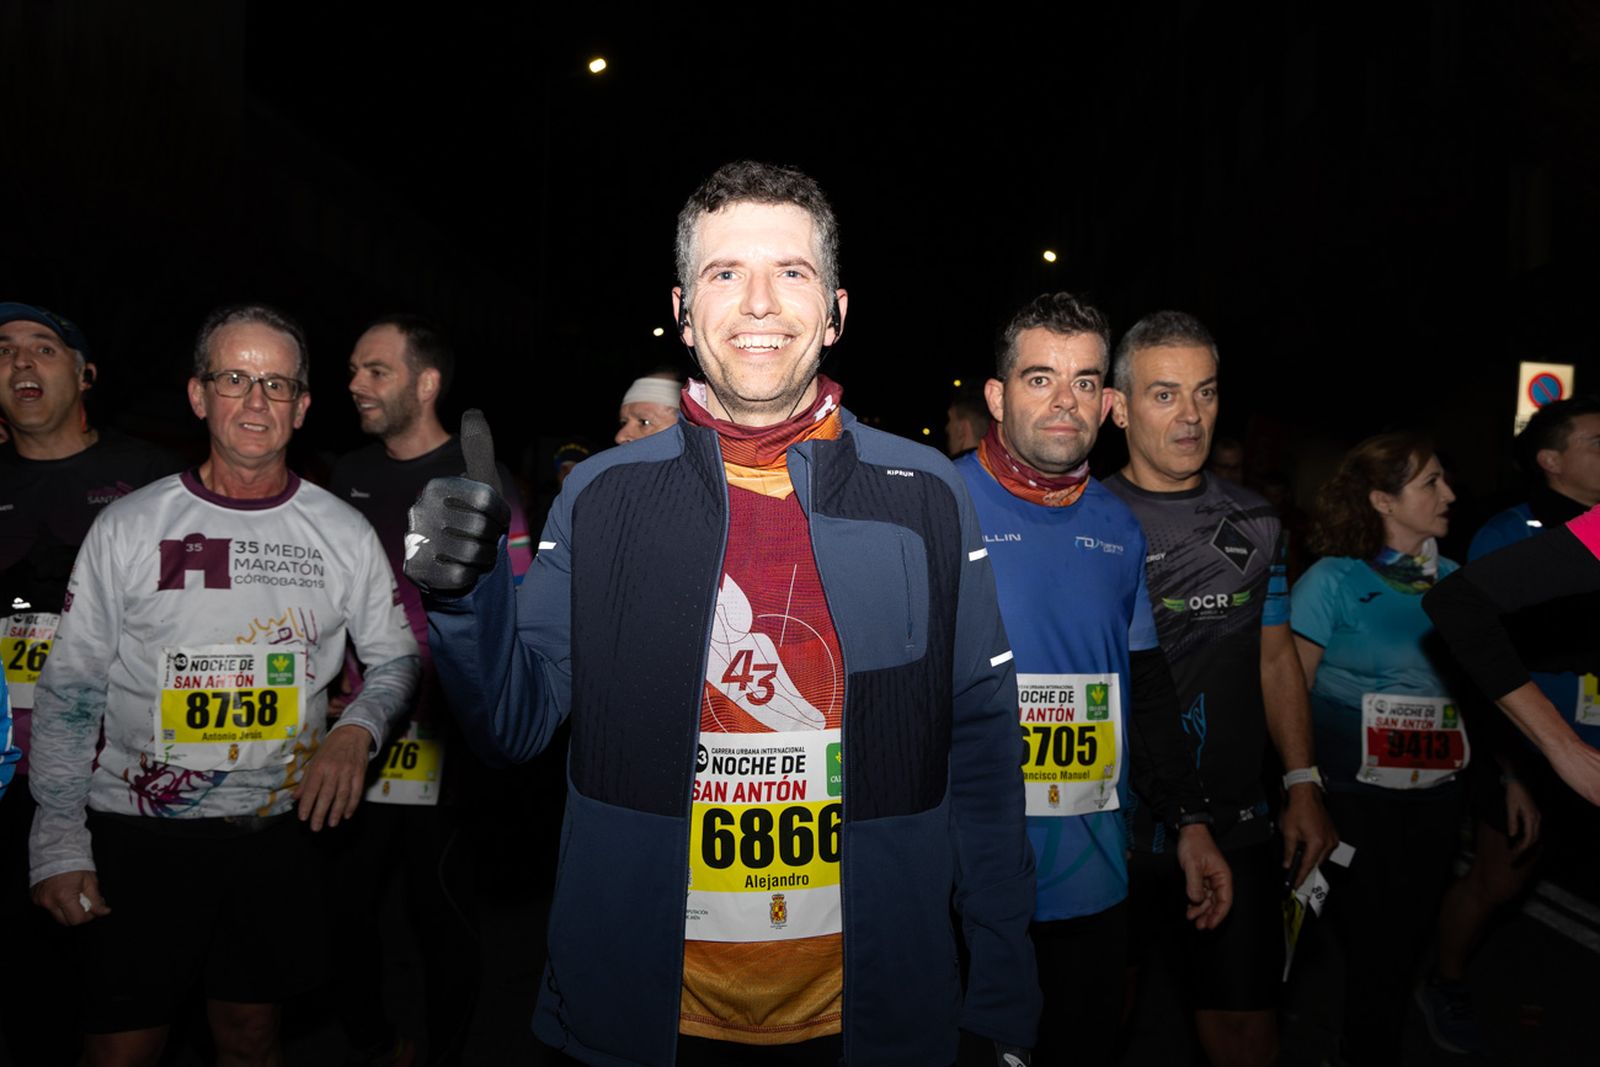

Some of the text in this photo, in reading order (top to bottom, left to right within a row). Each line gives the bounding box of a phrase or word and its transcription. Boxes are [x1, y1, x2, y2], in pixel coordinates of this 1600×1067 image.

[887, 469, 914, 477] KIPRUN
[982, 533, 1021, 542] LLIN
[185, 543, 203, 552] 35
[235, 541, 323, 561] 35 MEDIA
[234, 558, 324, 577] MARATÓN
[1189, 593, 1229, 610] OCR
[8, 640, 48, 672] 26
[190, 659, 254, 672] NOCHE DE
[174, 675, 202, 689] SAN
[205, 671, 254, 688] ANTÓN
[721, 650, 778, 706] 43
[1020, 690, 1075, 703] OCHE DE
[187, 690, 278, 729] 8758
[1026, 704, 1075, 722] ANTÓN
[202, 732, 237, 742] Antonio
[1388, 731, 1450, 759] 9413
[389, 742, 419, 770] 76
[711, 746, 805, 755] CARRERA URBANA INTERNACIONAL
[711, 755, 806, 775] NOCHE DE
[1024, 771, 1090, 780] ancisco Manuel
[692, 775, 807, 803] SAN ANTÓN
[702, 803, 842, 870] 6866
[744, 872, 809, 890] Alejandro
